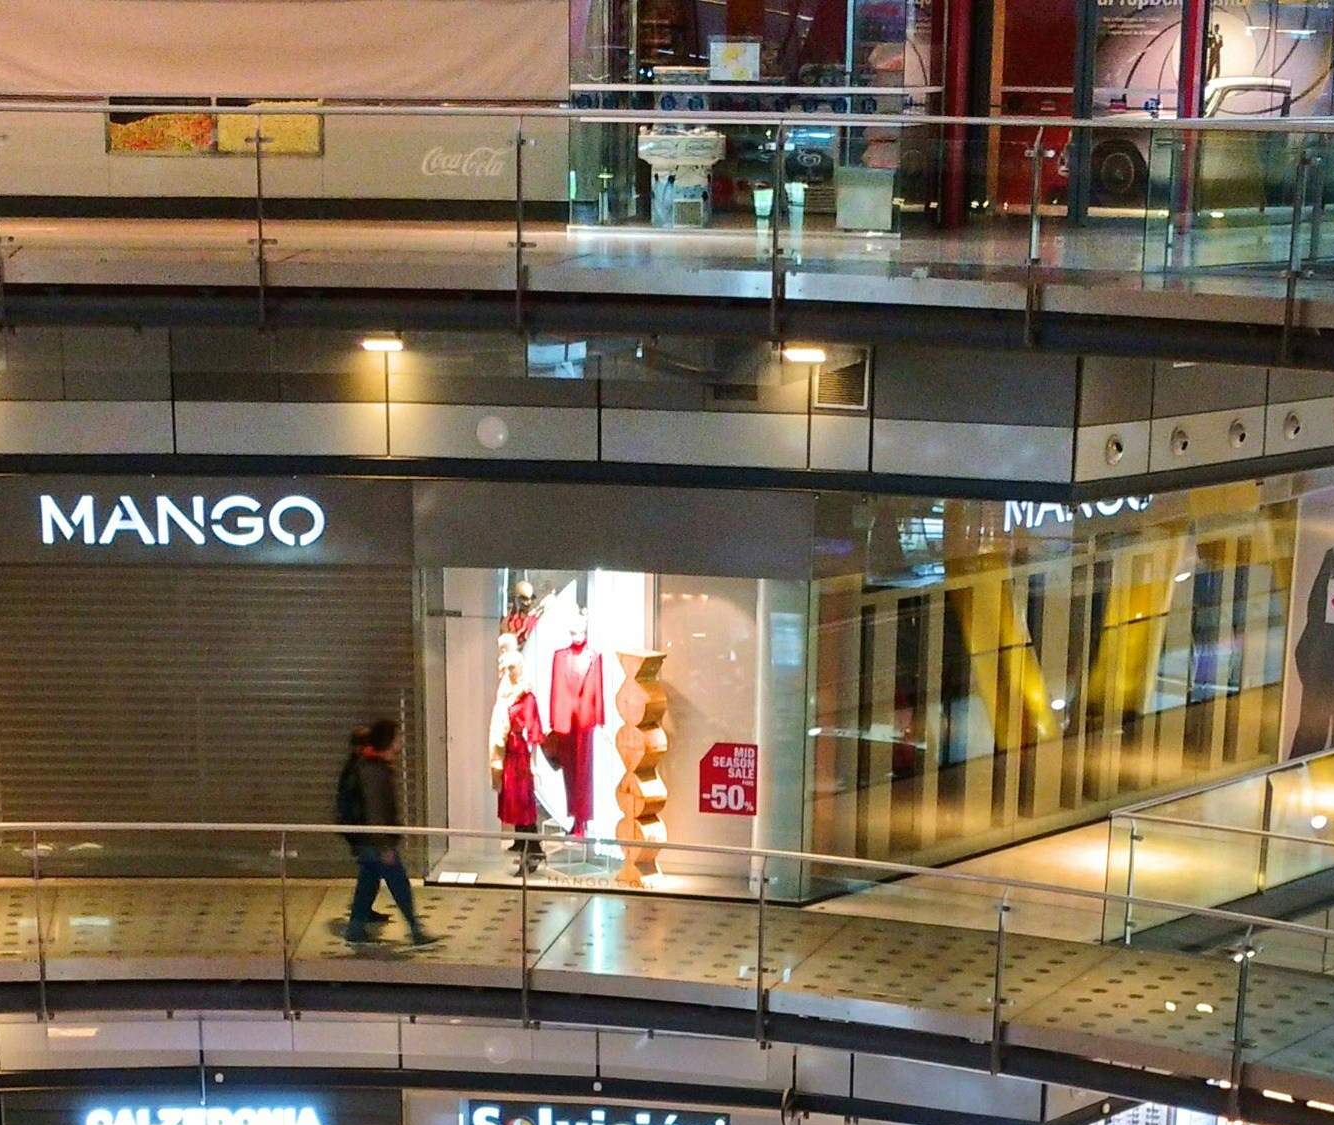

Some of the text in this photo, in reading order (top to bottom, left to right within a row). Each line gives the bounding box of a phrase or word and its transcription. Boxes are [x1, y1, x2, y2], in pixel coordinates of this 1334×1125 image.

[39, 494, 326, 547] MANGO
[733, 746, 756, 758] MID
[711, 755, 756, 769] SEASON
[727, 767, 755, 780] SALE
[701, 783, 755, 812] -50%
